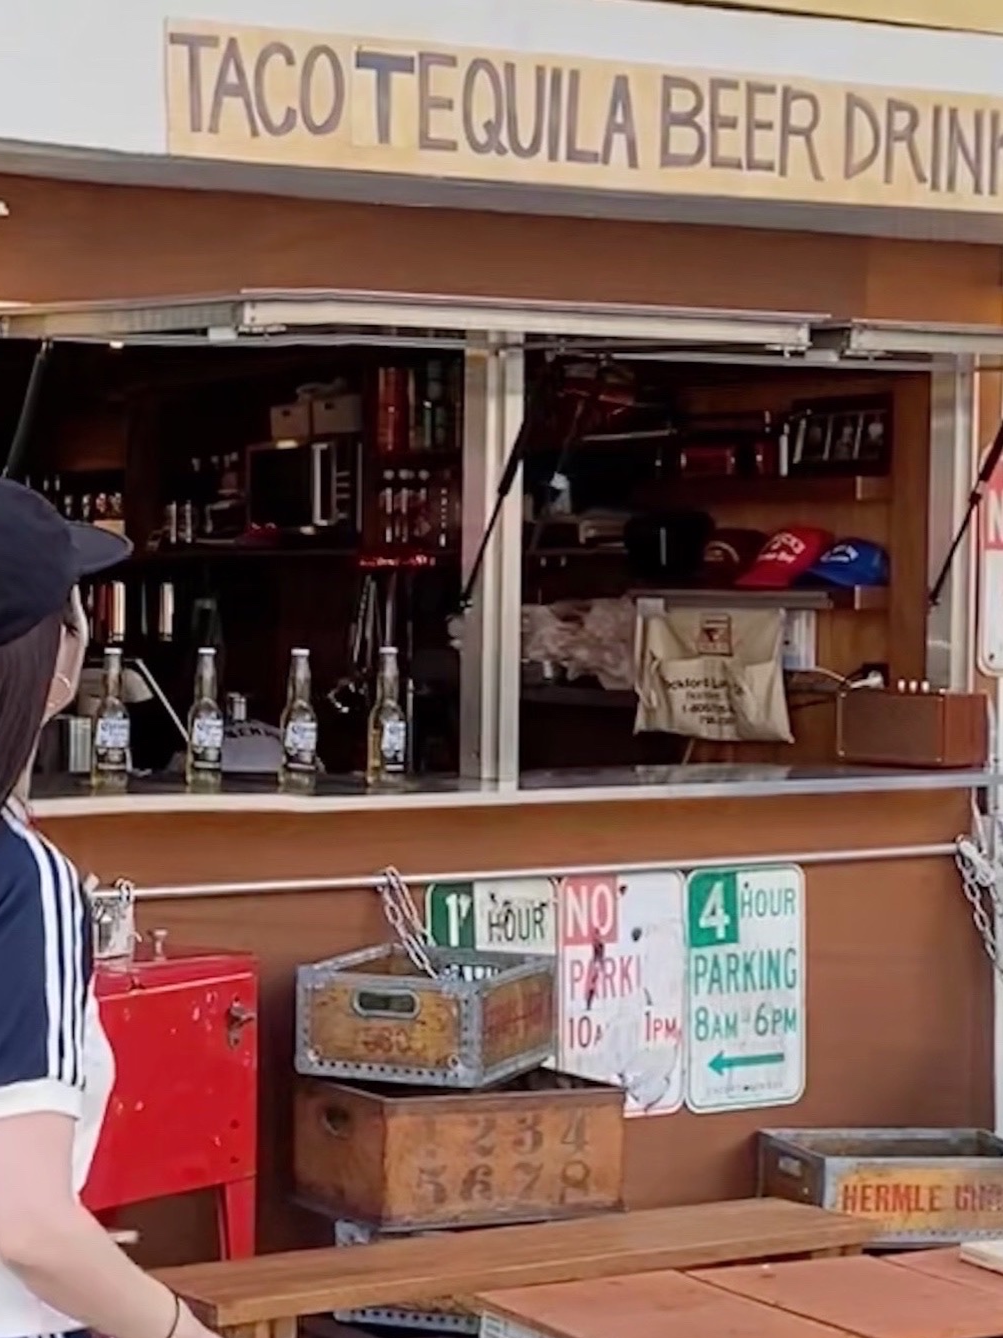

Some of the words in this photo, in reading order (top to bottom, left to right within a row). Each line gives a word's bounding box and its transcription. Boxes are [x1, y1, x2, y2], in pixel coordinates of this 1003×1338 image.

[168, 32, 345, 137] TACO
[355, 48, 639, 168] TEQUILA
[660, 74, 825, 182] BEER
[487, 901, 547, 943] HOUR
[566, 885, 612, 939] NO
[699, 880, 730, 941] 4
[739, 887, 796, 919] HOUR
[571, 955, 642, 1001] PARKI
[694, 948, 797, 998] PARKING
